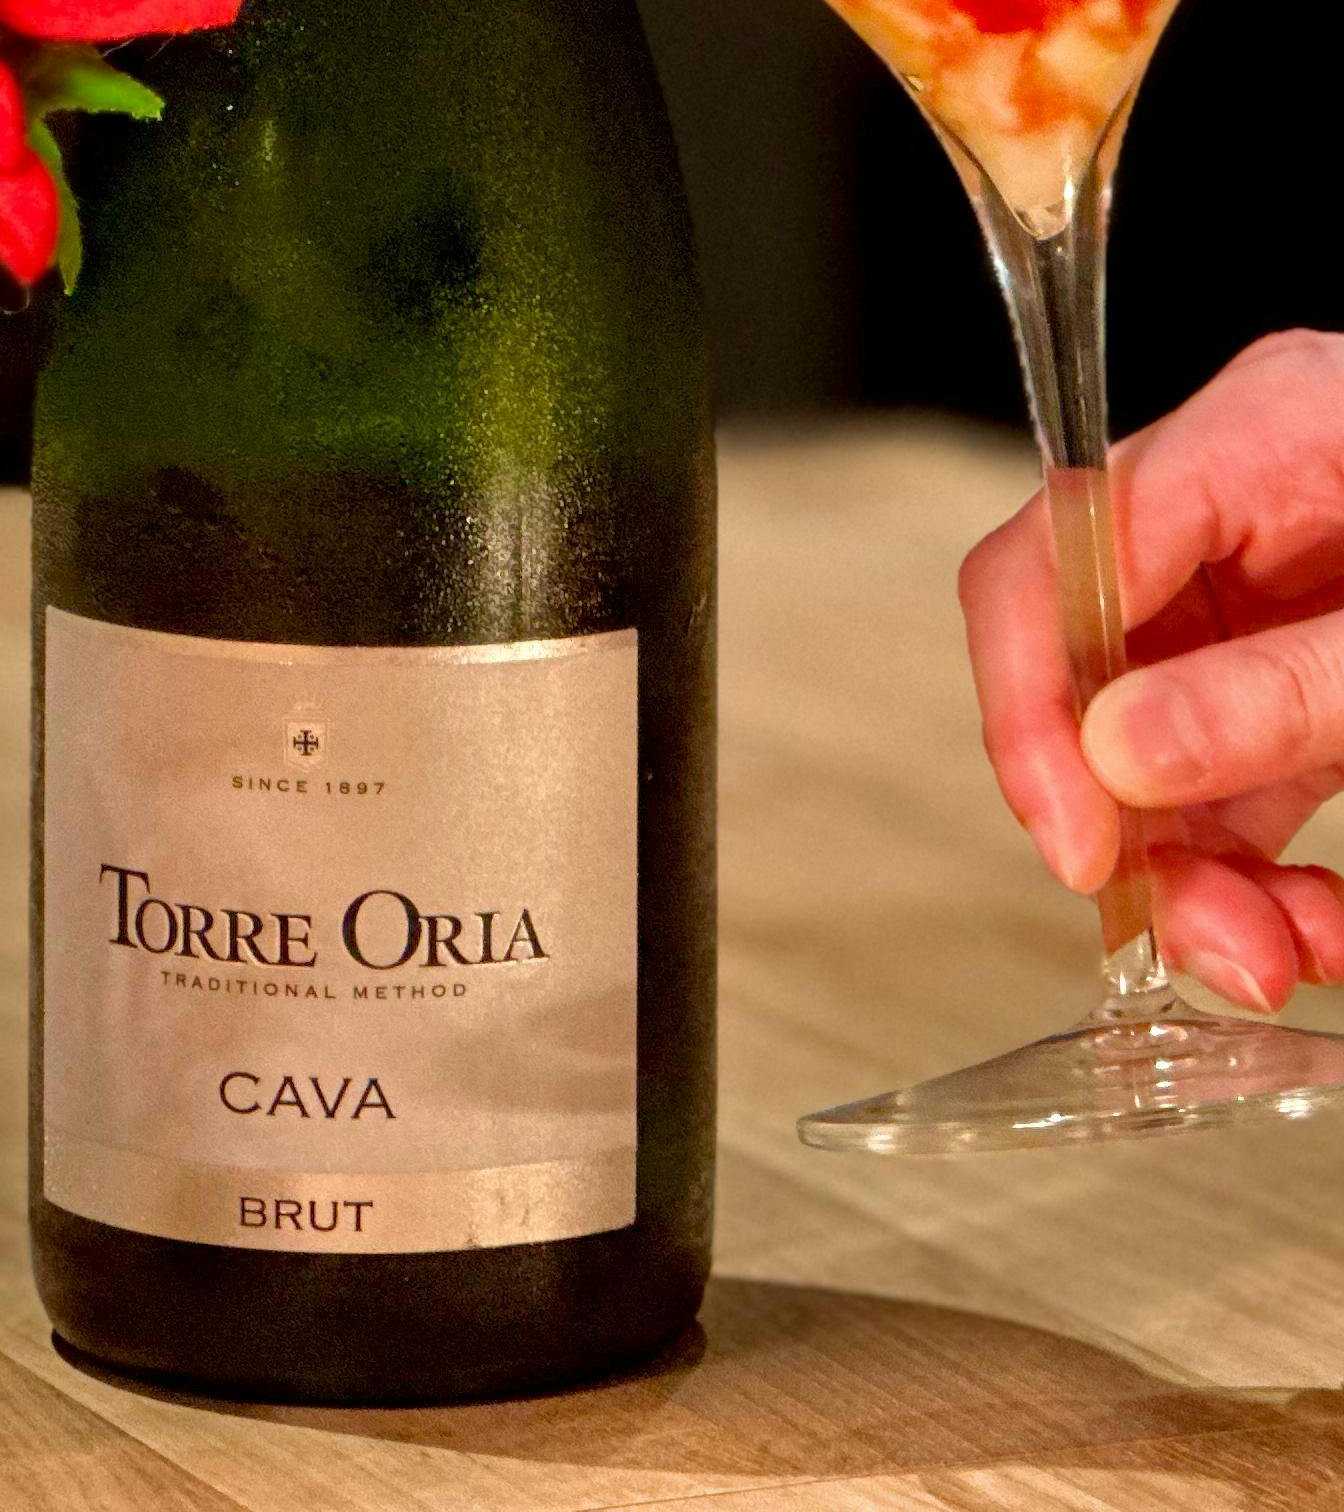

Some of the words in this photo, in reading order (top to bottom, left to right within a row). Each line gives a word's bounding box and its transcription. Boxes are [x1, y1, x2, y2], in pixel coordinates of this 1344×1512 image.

[231, 775, 309, 794] SINCE
[325, 781, 386, 795] 1897
[100, 863, 318, 968] TORRE
[342, 889, 551, 970] ORIA
[160, 970, 337, 1000] TRADITIONAL
[353, 983, 468, 1000] METHOD
[219, 1071, 396, 1120] CAVA
[239, 1197, 374, 1233] BRUT
